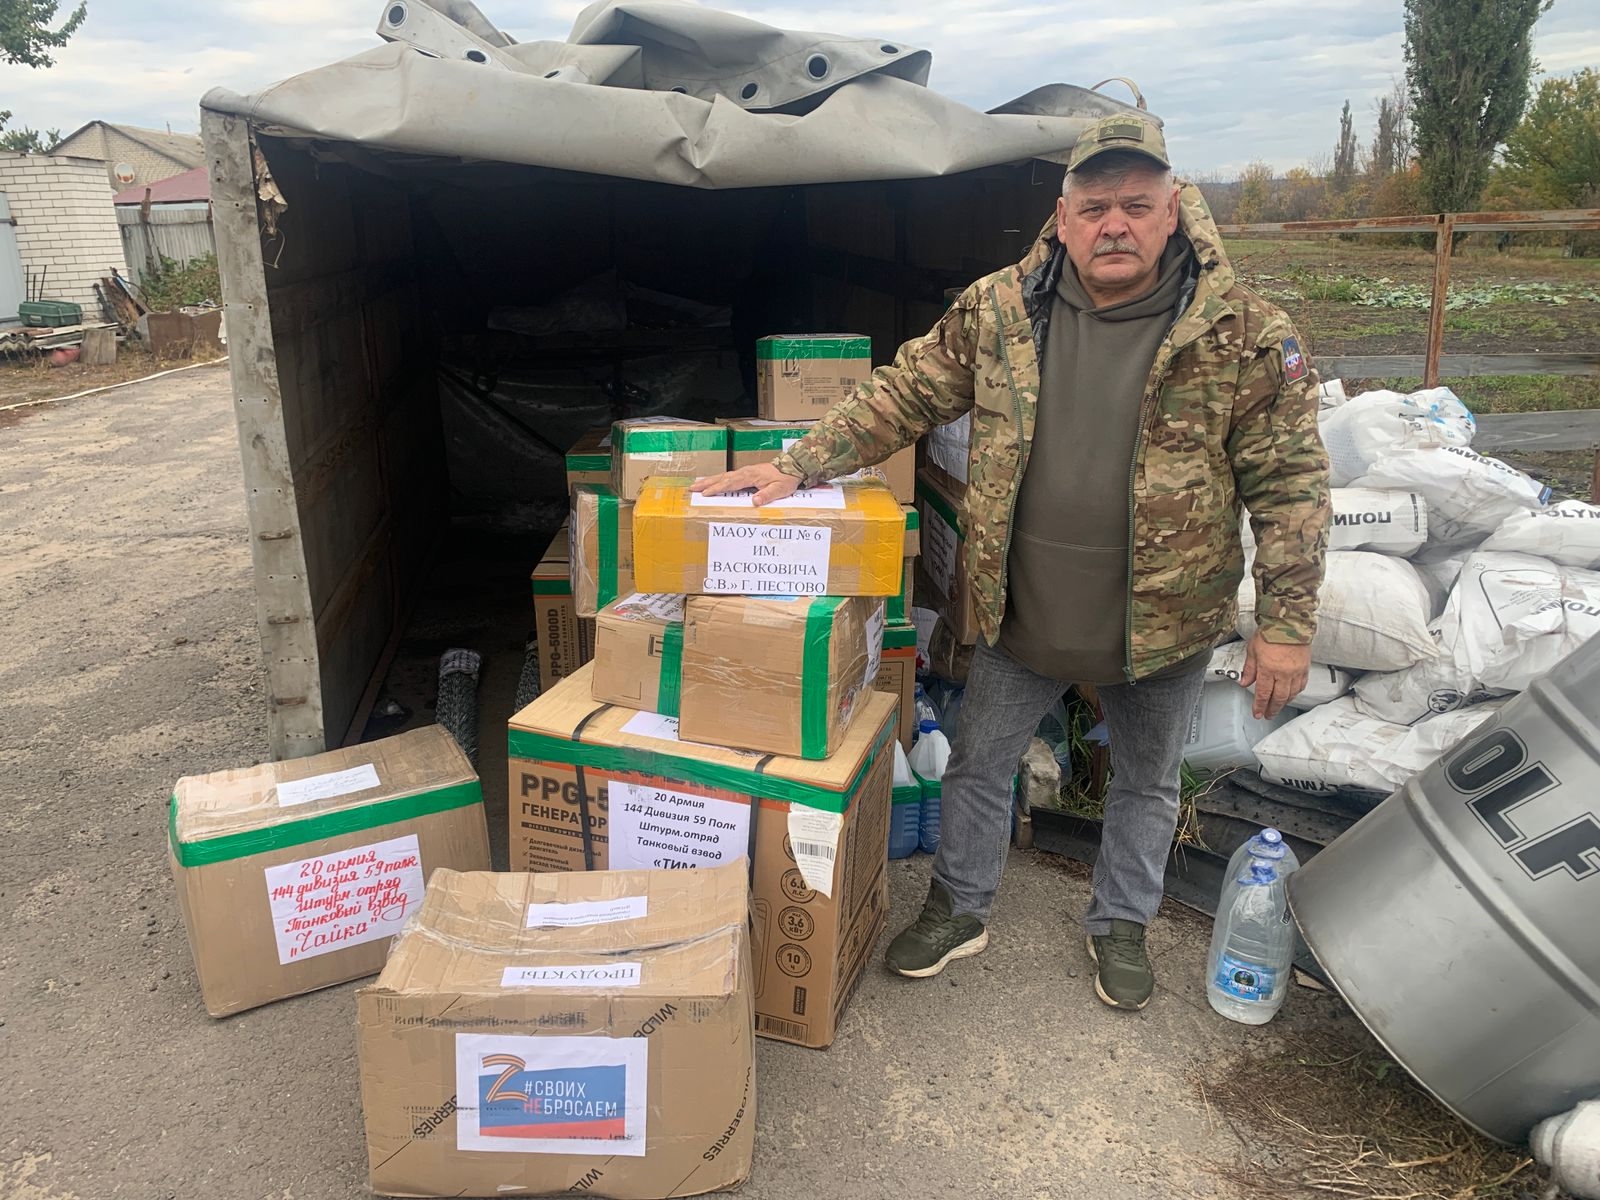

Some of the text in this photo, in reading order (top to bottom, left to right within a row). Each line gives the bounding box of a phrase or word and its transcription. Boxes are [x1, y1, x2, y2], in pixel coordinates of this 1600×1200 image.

[712, 526, 757, 538] МАОУ
[761, 528, 792, 540] «СШ
[814, 530, 821, 541] 6
[753, 545, 779, 557] ИМ.
[713, 561, 818, 576] ВАСЮКОВИЧА
[703, 578, 825, 594] С.В.» Г. ПЕСТОВО
[547, 608, 562, 677] PPG-5000D
[654, 792, 705, 809] 20 Армия
[522, 802, 608, 828] ГЕНЕРАОР
[624, 803, 736, 831] 144 Дивизия 59 Полк
[637, 836, 722, 860] Танковый взвод
[300, 850, 377, 878] 20 армия
[272, 884, 294, 901] 144
[296, 871, 360, 903] дивизия
[356, 877, 401, 900] отряд
[285, 893, 408, 933] Танковый взвод
[788, 916, 804, 928] 3.6
[786, 953, 801, 965] 10
[520, 967, 635, 980] ПРОДУКТЫ
[524, 1080, 586, 1099] #СВОИХ
[703, 1066, 752, 1162] WILDBERRIES
